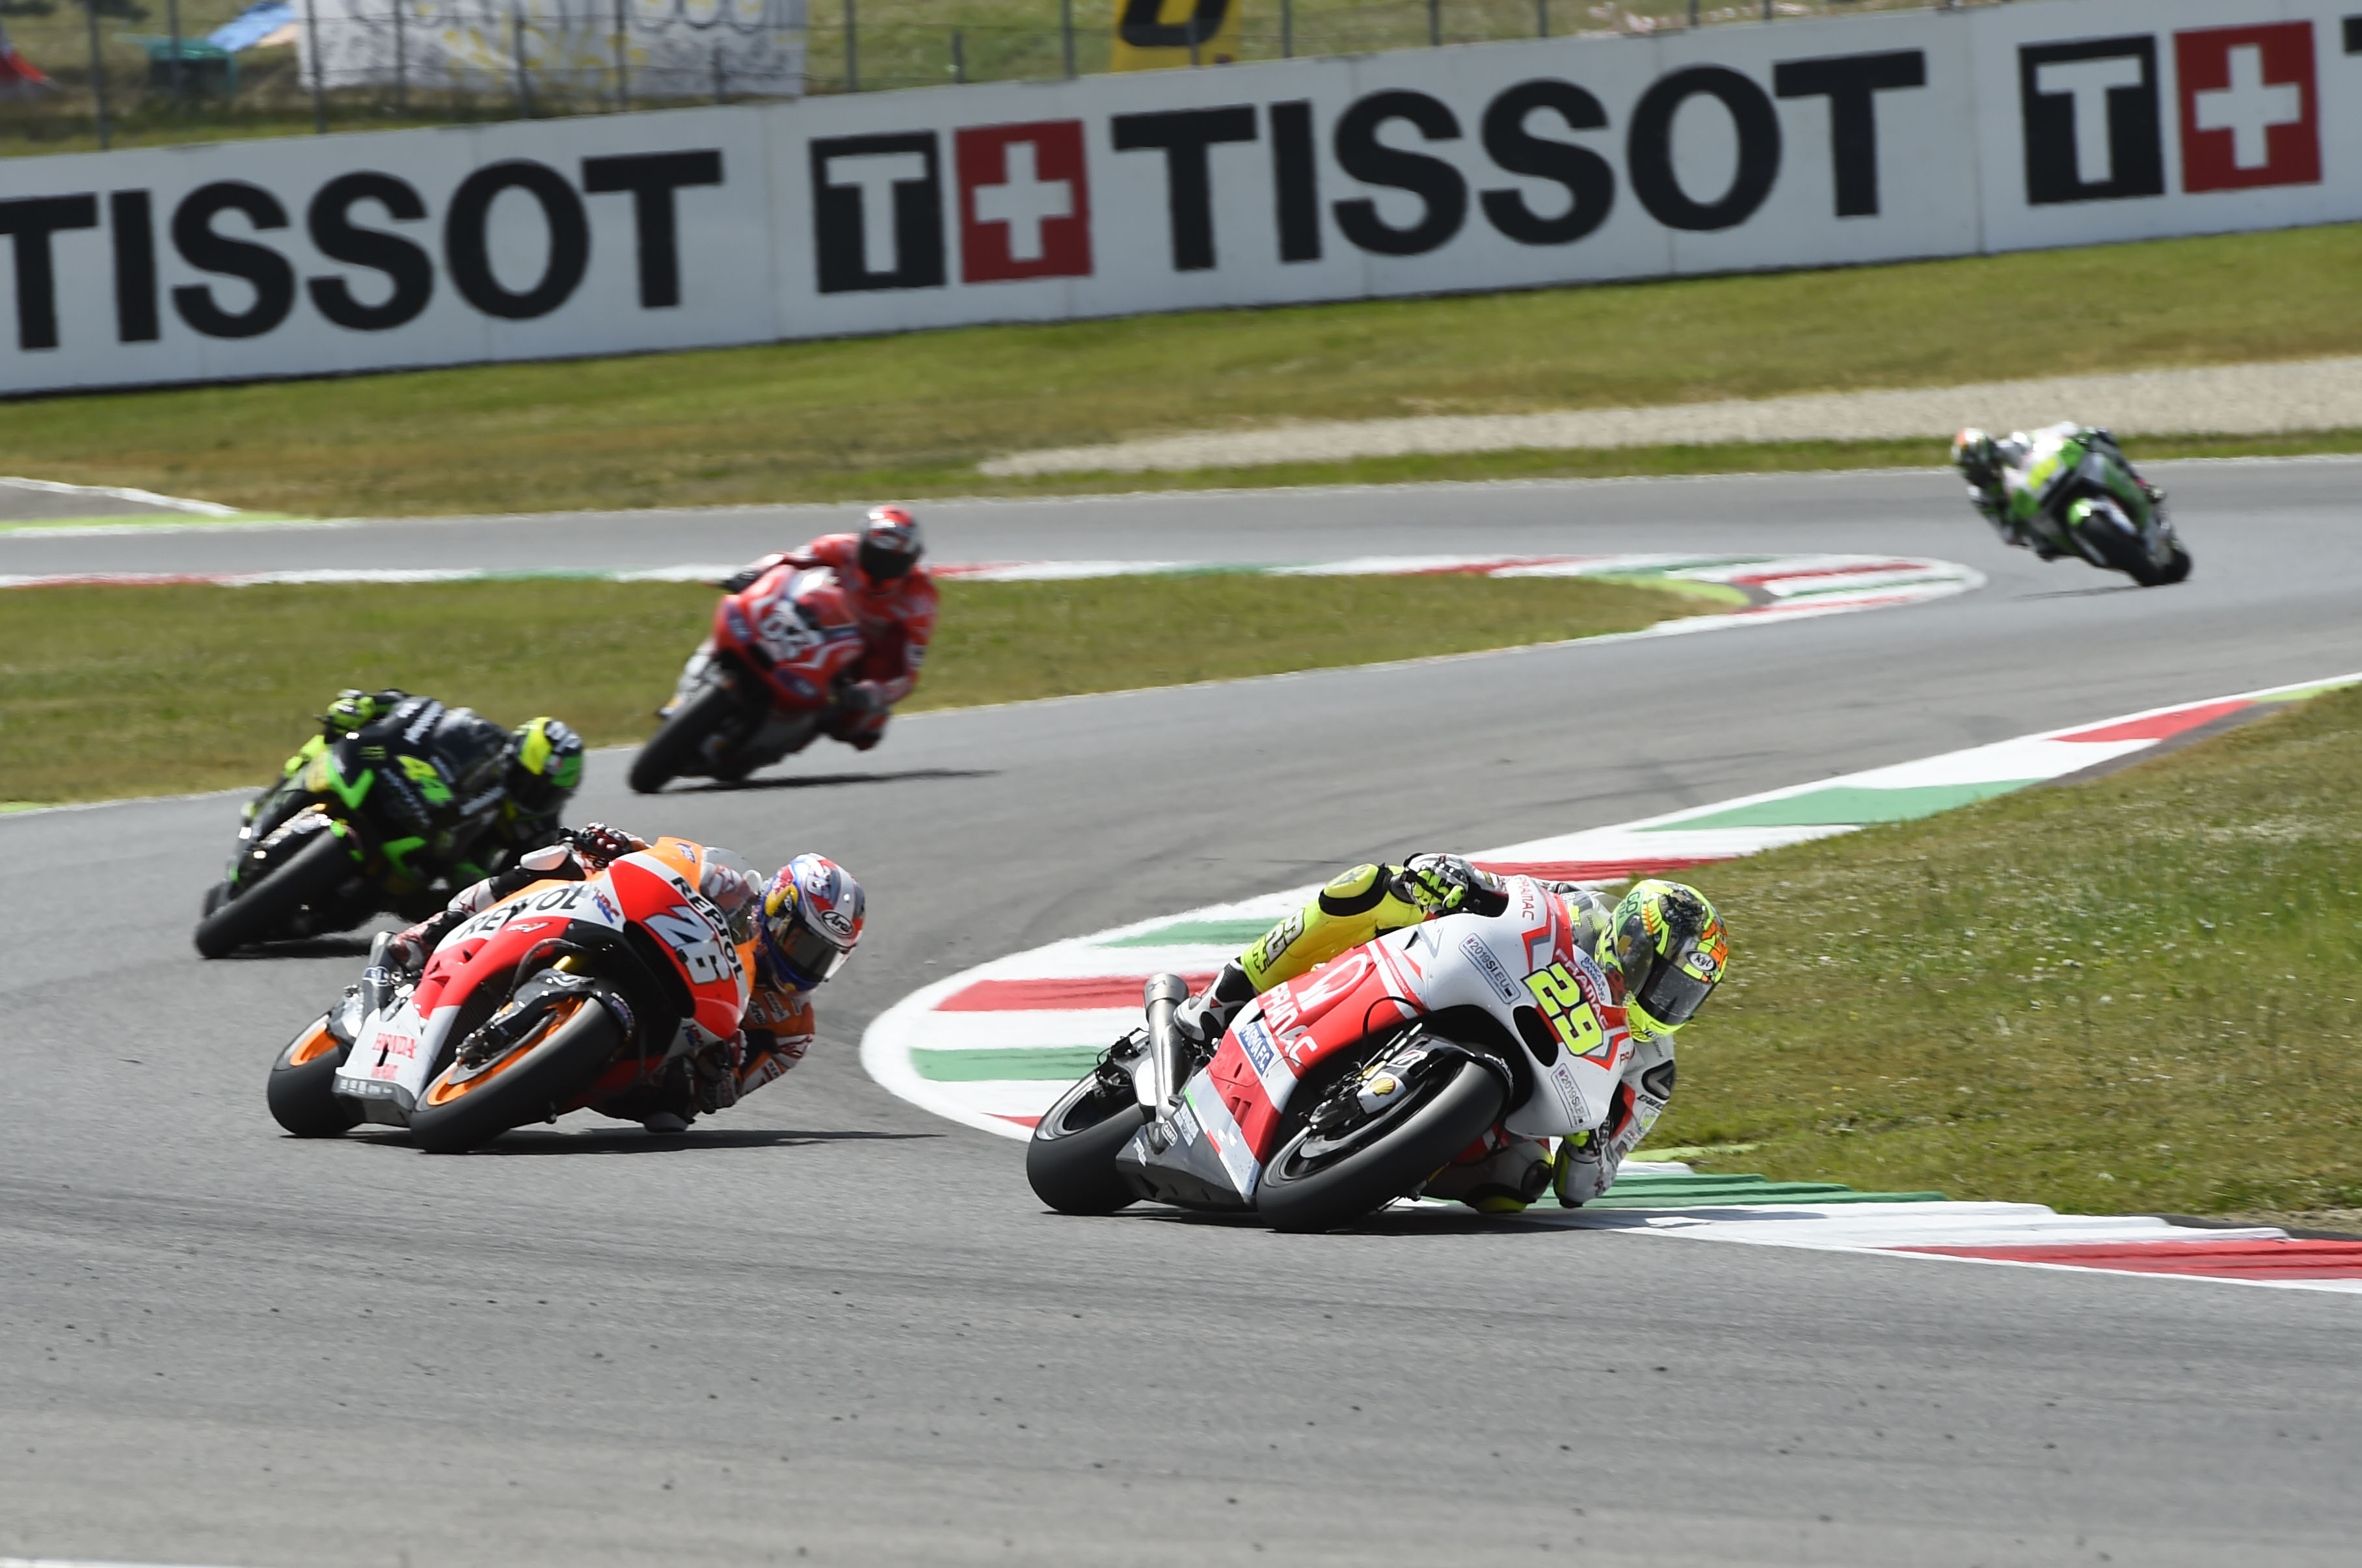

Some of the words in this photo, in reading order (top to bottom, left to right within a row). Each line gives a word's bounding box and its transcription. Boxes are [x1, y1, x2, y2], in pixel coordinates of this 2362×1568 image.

[826, 152, 928, 273] T
[1110, 49, 1926, 271] TISSOT
[2036, 55, 2143, 183] T
[0, 150, 722, 349] TISSOT
[641, 904, 730, 984] 26
[671, 876, 742, 981] REPSOL
[1260, 981, 1318, 1067] PRAMAC
[1520, 961, 1604, 1056] 29
